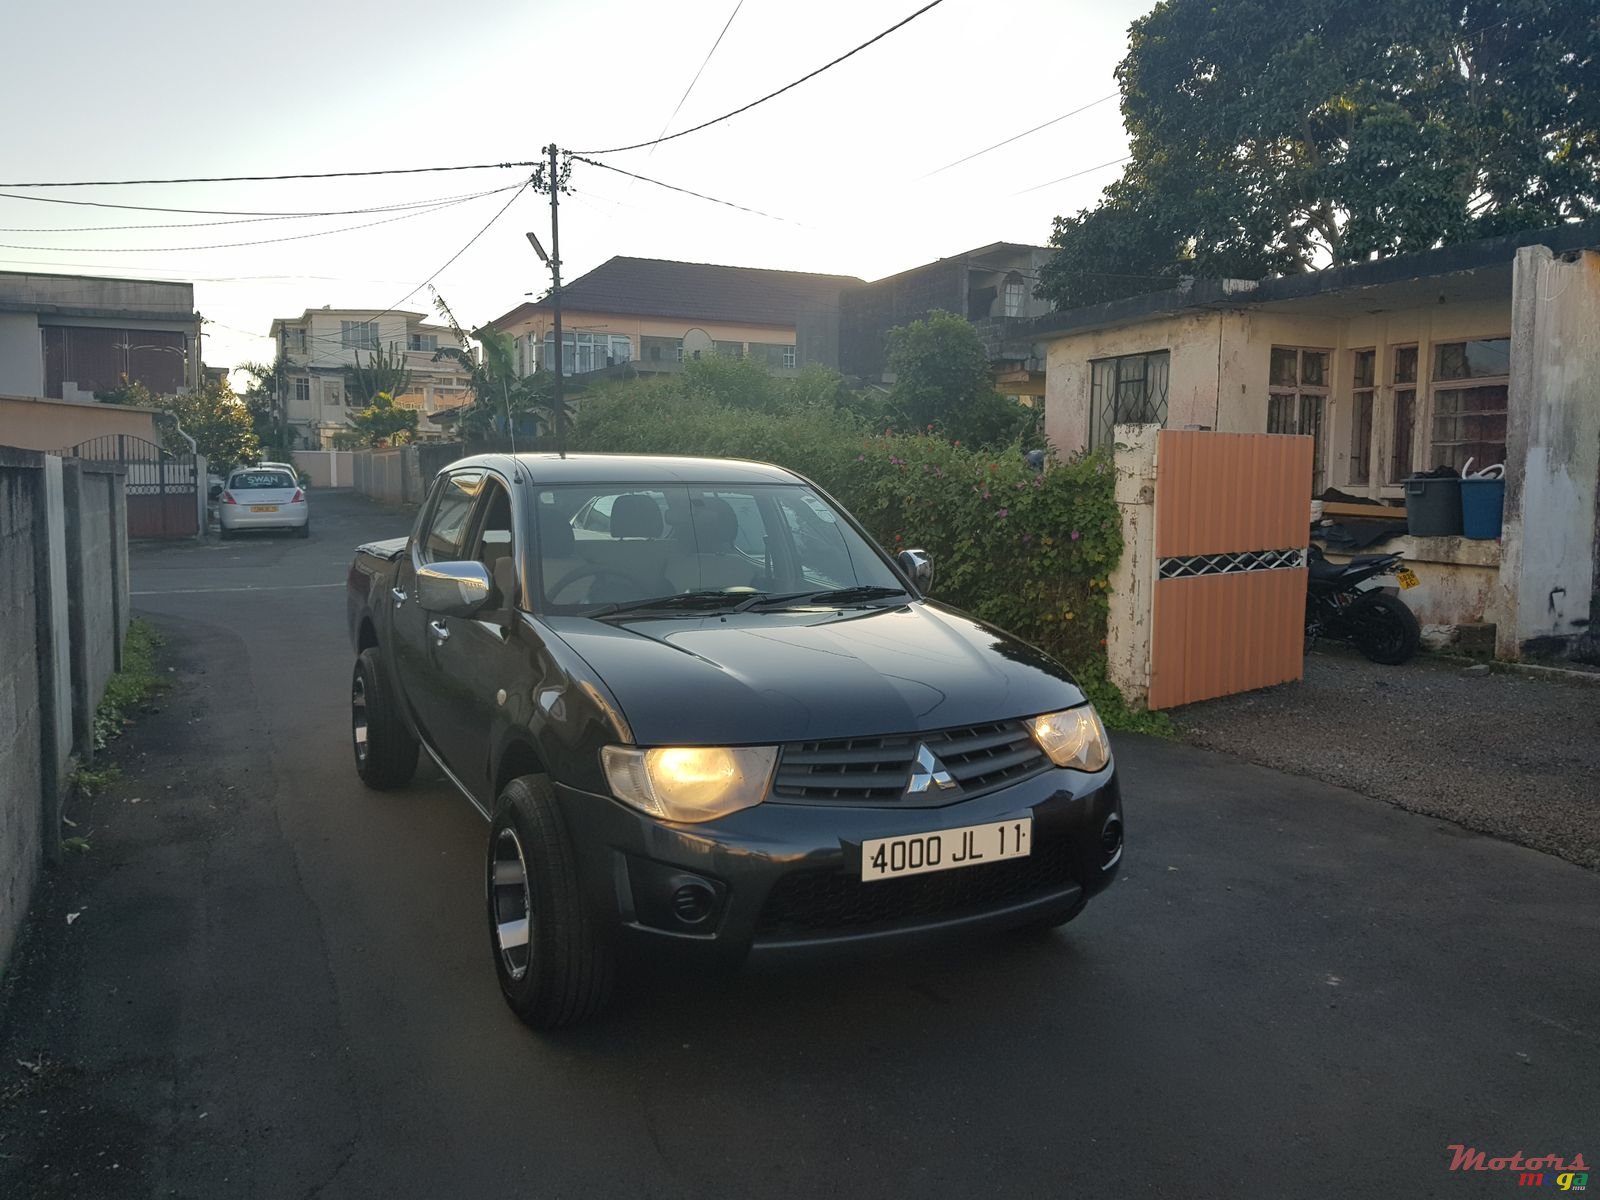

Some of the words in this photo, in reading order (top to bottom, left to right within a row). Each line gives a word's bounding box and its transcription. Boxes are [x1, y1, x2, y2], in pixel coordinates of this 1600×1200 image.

[247, 475, 279, 484] SWAN
[872, 836, 941, 873] 4000
[952, 831, 983, 862] JL
[998, 824, 1021, 855] 11
